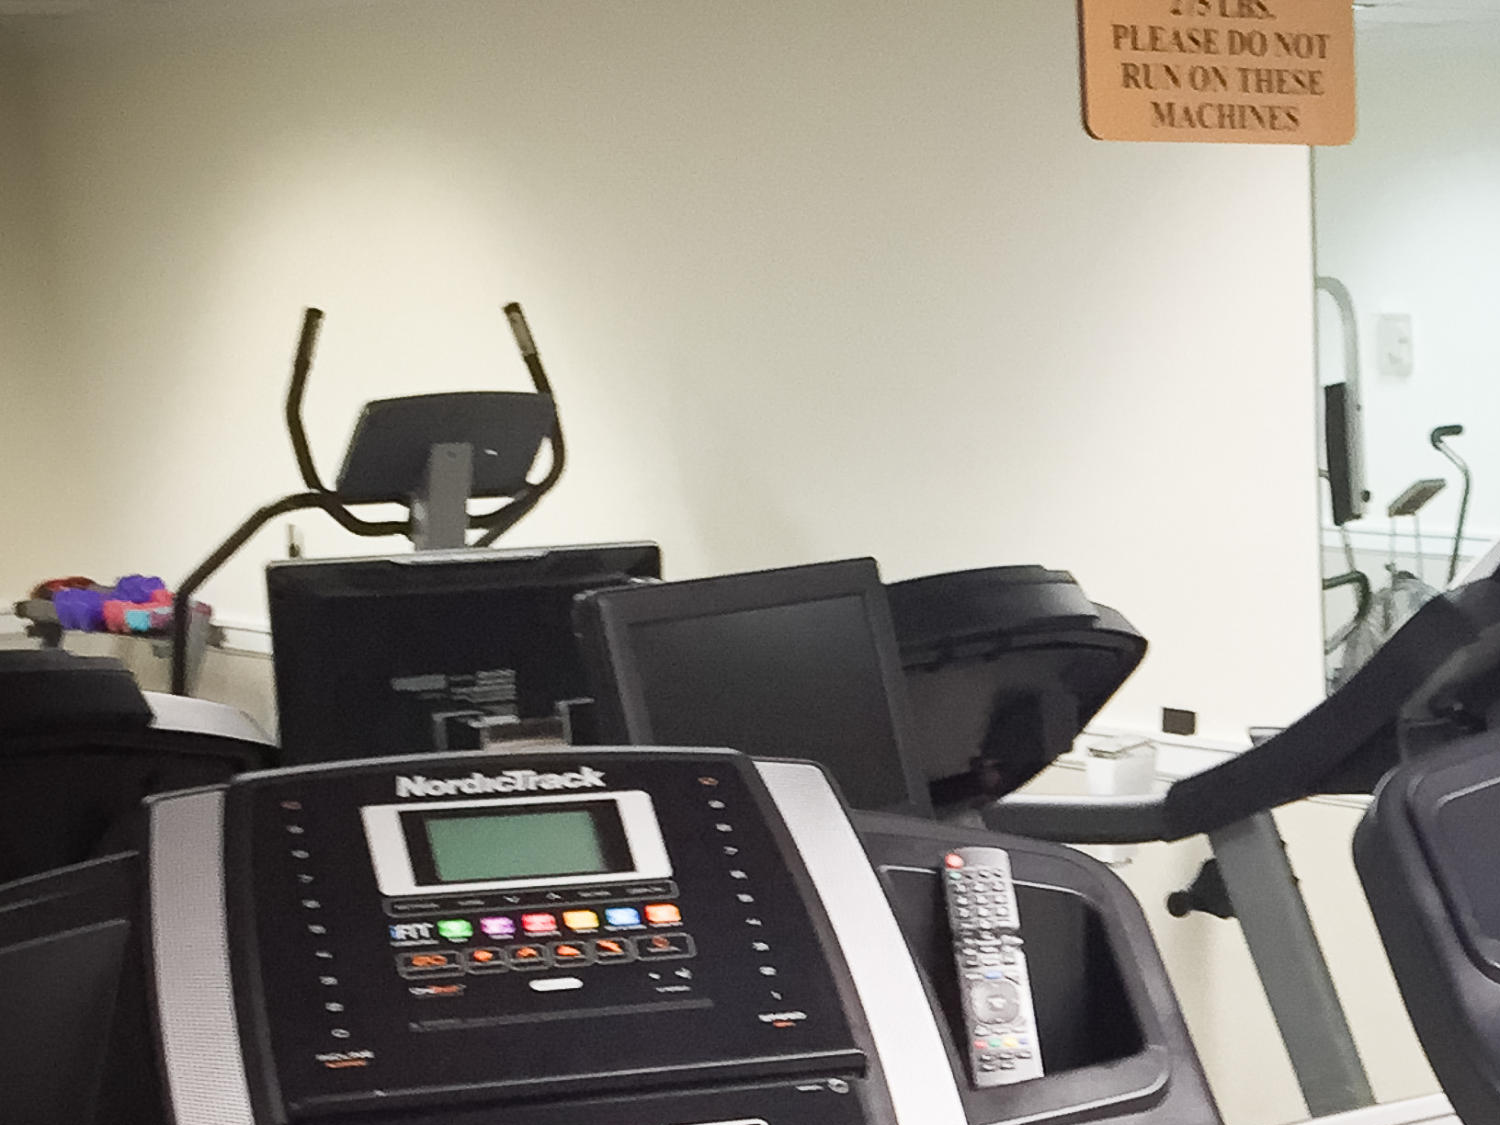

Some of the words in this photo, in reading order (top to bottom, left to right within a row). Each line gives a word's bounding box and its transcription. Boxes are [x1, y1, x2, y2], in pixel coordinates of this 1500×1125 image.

[1111, 23, 1218, 55] PLEASE
[1228, 29, 1268, 57] DO
[1274, 31, 1331, 59] NOT
[1120, 62, 1180, 90] RUN
[1187, 65, 1229, 92] ON
[1237, 67, 1325, 96] THESE
[1150, 101, 1301, 132] MACHINES
[395, 766, 606, 797] NordicTrack
